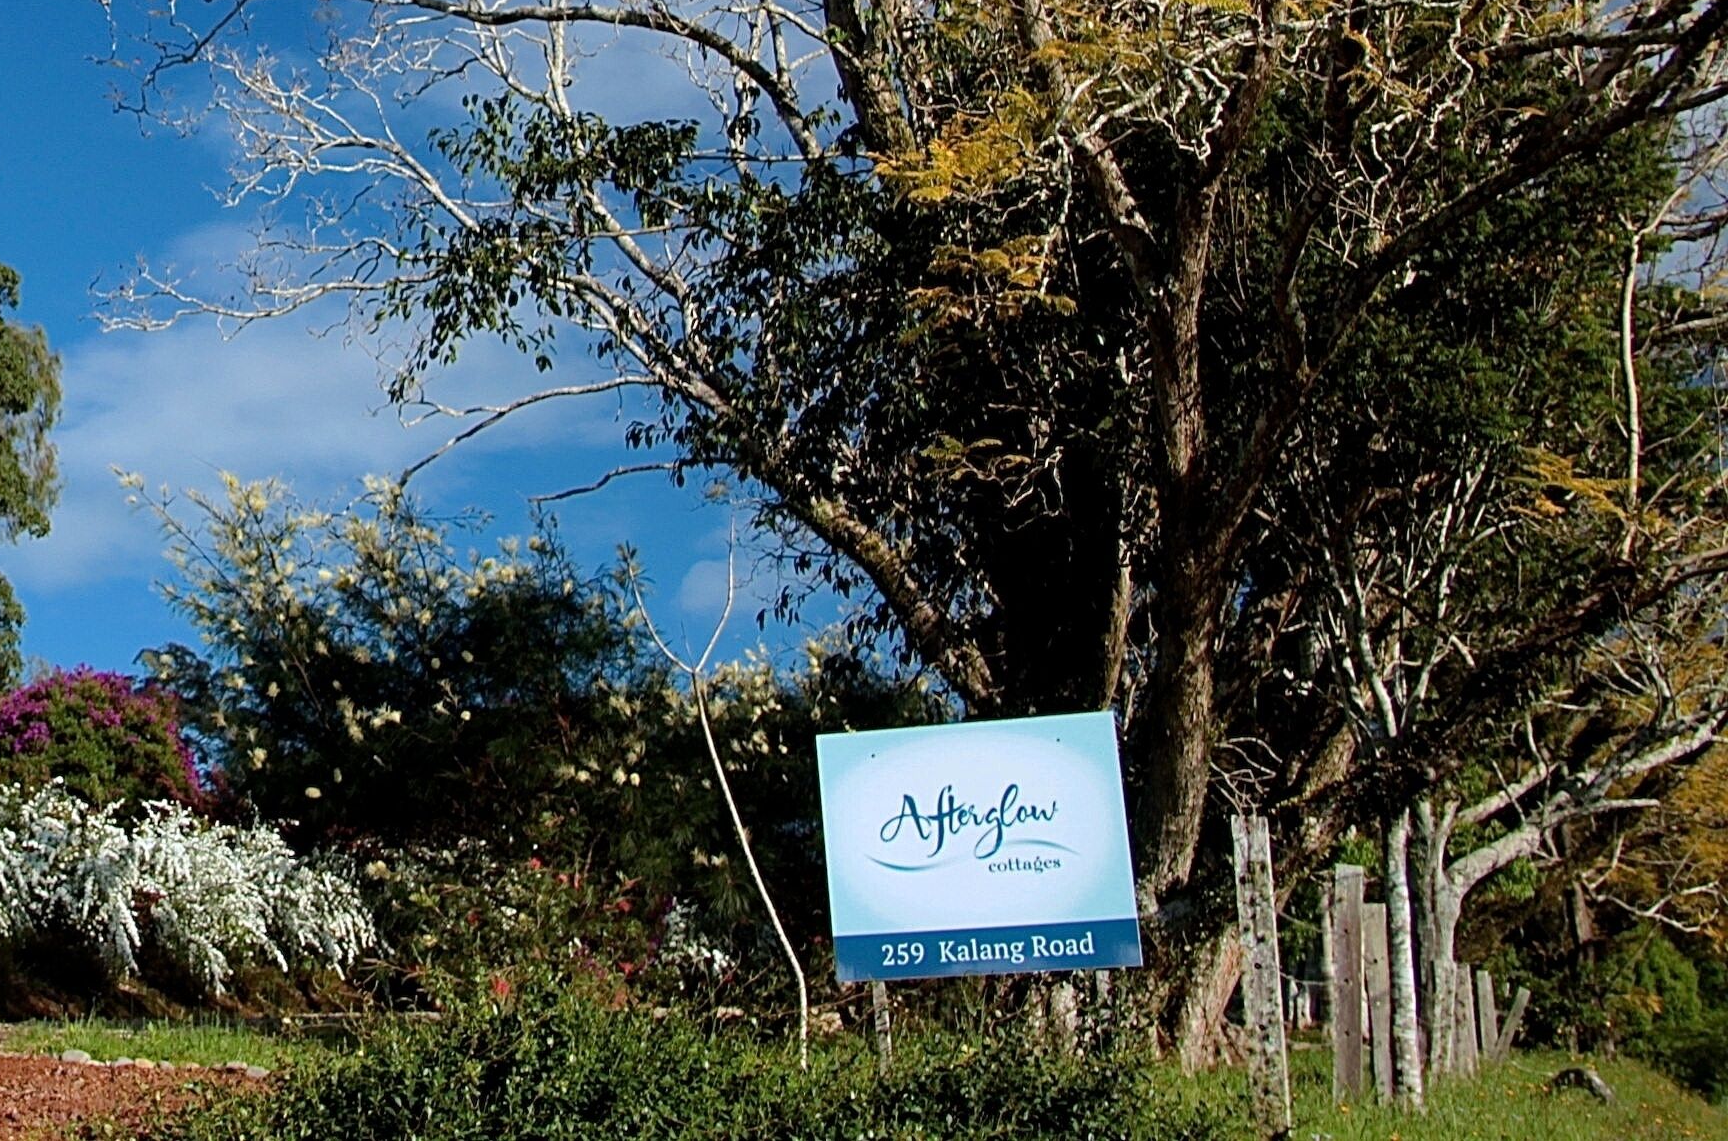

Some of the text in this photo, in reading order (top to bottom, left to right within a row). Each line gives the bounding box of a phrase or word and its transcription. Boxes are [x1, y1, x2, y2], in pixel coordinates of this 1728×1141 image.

[880, 784, 1058, 860] Afterglow
[988, 856, 1062, 874] cottages
[881, 932, 1096, 967] 259 Kalang Road
